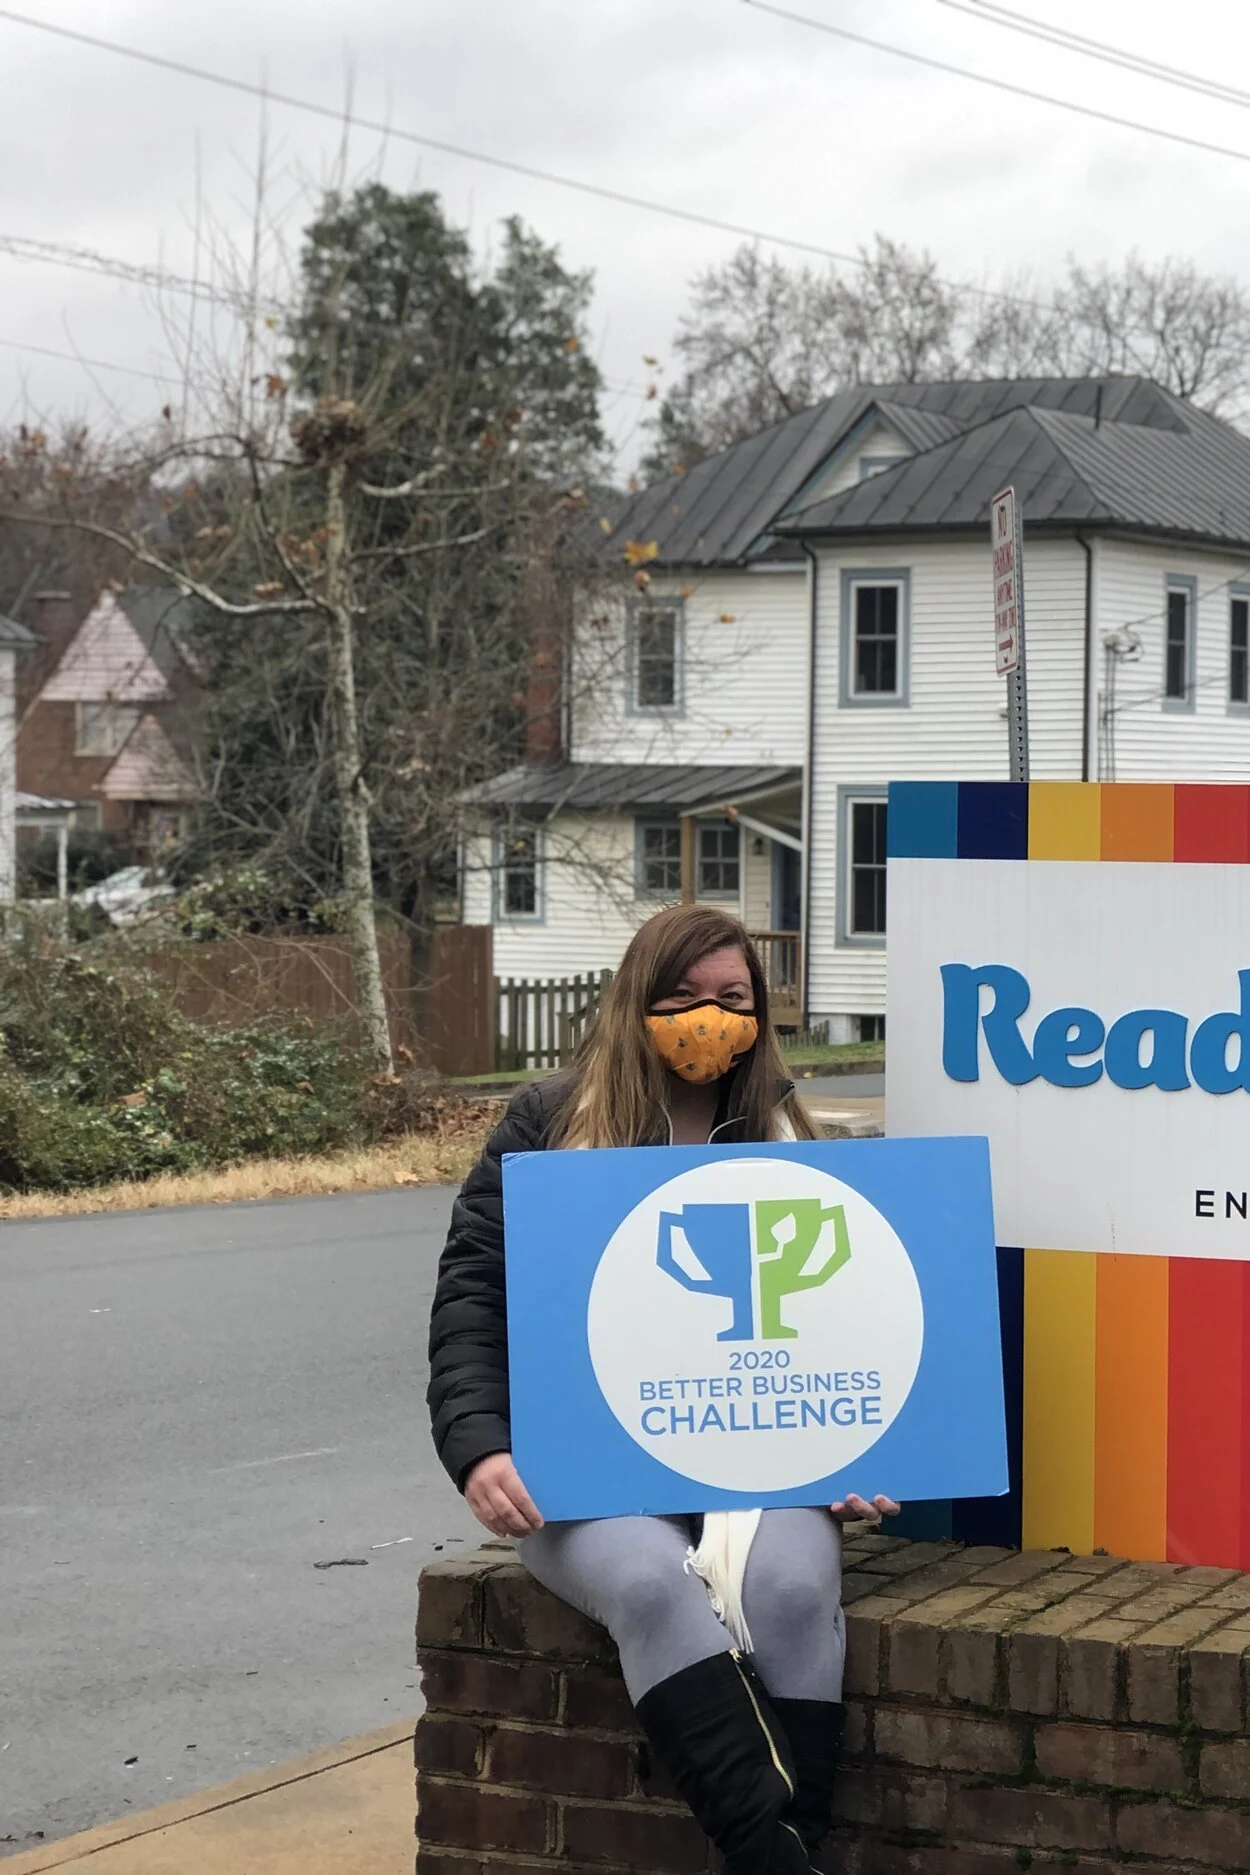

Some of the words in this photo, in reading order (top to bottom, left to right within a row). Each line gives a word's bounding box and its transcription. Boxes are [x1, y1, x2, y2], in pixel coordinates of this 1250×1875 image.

[728, 1349, 791, 1371] 2020
[639, 1376, 743, 1401] BETTER
[752, 1370, 882, 1396] BUSINESS
[640, 1395, 883, 1436] CHALLENGE
